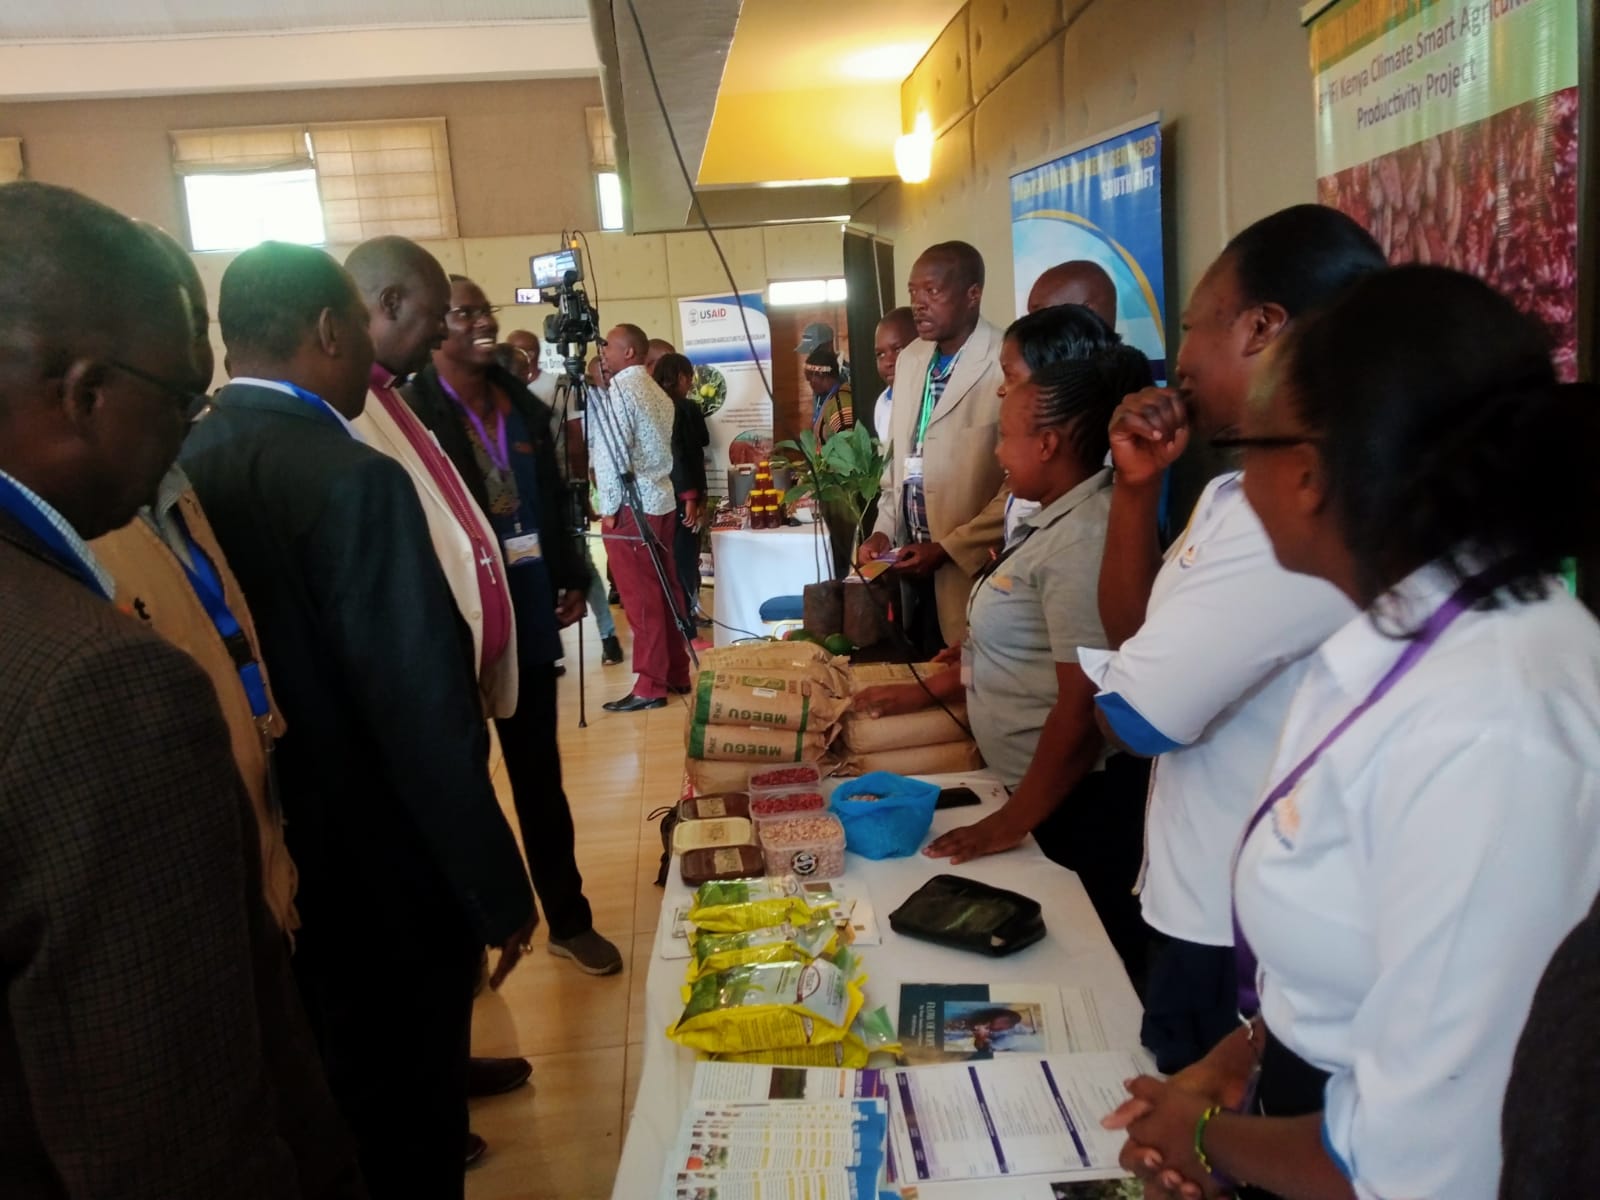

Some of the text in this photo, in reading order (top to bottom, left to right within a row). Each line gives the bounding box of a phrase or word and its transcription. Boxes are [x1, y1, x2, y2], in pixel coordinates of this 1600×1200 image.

[1340, 68, 1369, 99] Kenya
[1370, 45, 1413, 83] Climate
[1415, 18, 1457, 58] Smart
[1356, 55, 1477, 131] Productivity Project
[1101, 175, 1133, 201] SOUTH
[700, 308, 727, 320] USAID
[728, 708, 787, 725] MBEGU
[722, 742, 782, 758] MBEGU
